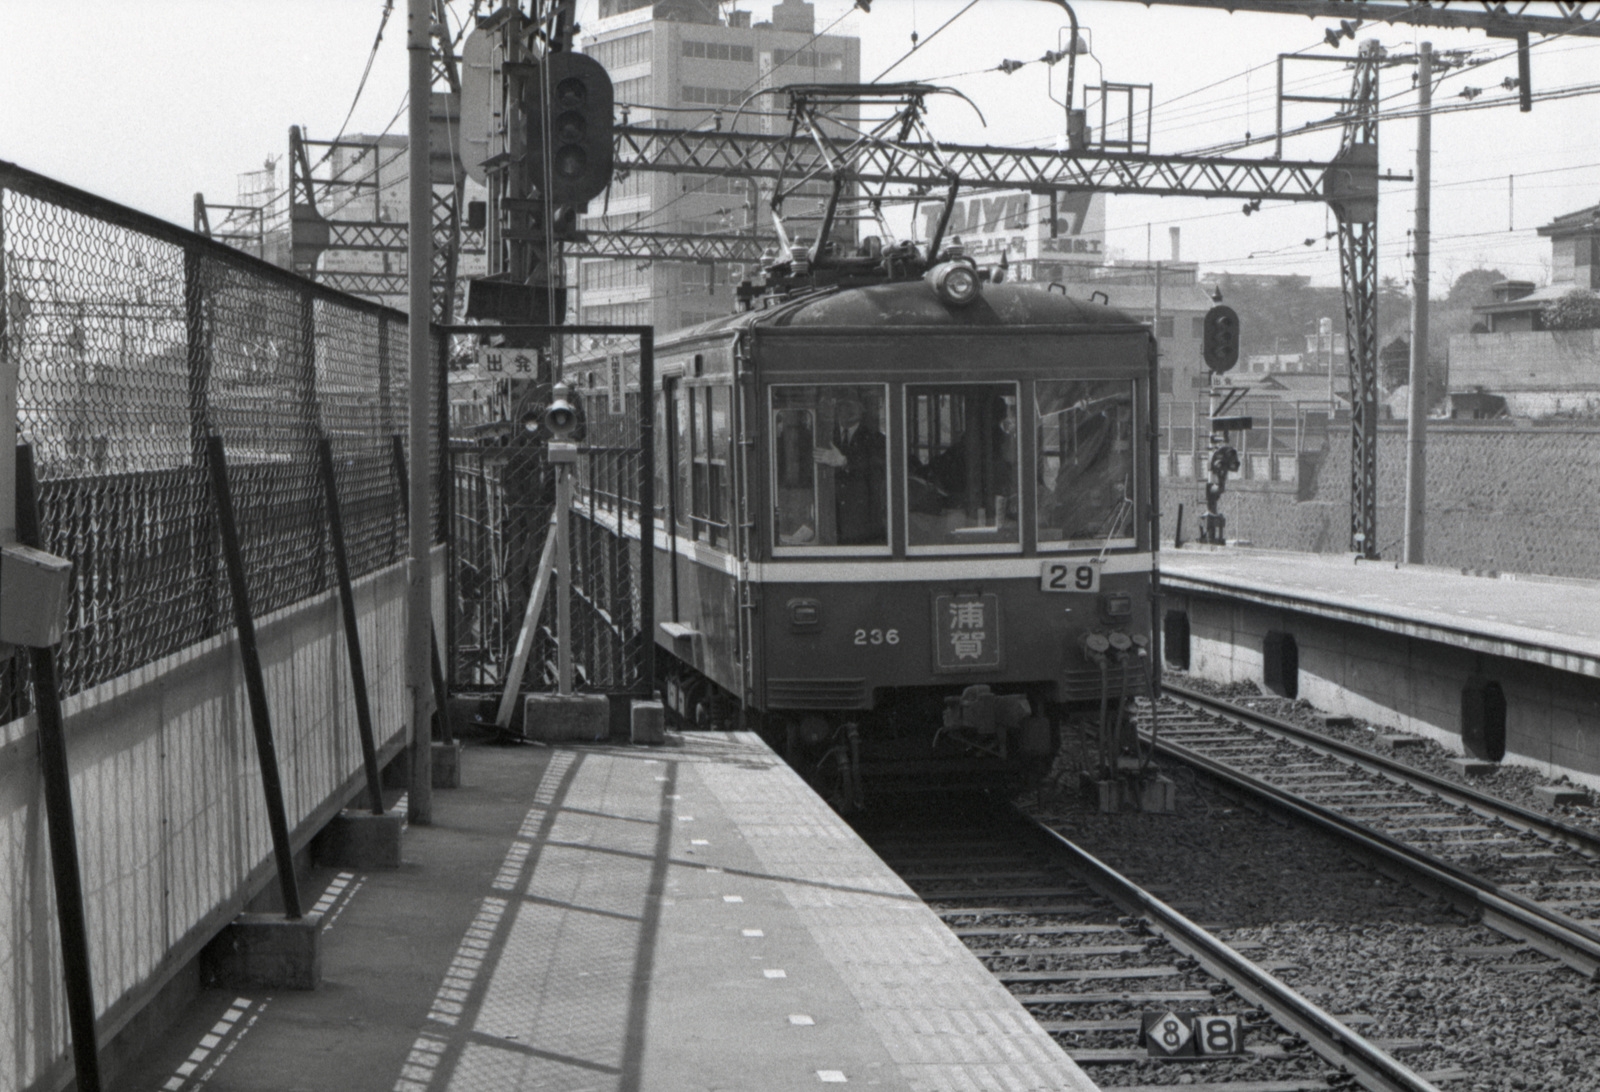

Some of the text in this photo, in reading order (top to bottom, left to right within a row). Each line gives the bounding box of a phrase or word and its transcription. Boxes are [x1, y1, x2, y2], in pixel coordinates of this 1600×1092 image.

[487, 354, 531, 372] 出発
[1050, 565, 1093, 590] 29
[854, 629, 900, 645] 236
[950, 602, 986, 660] 浦賀
[1163, 1020, 1179, 1047] 8
[1206, 1019, 1234, 1052] 8
